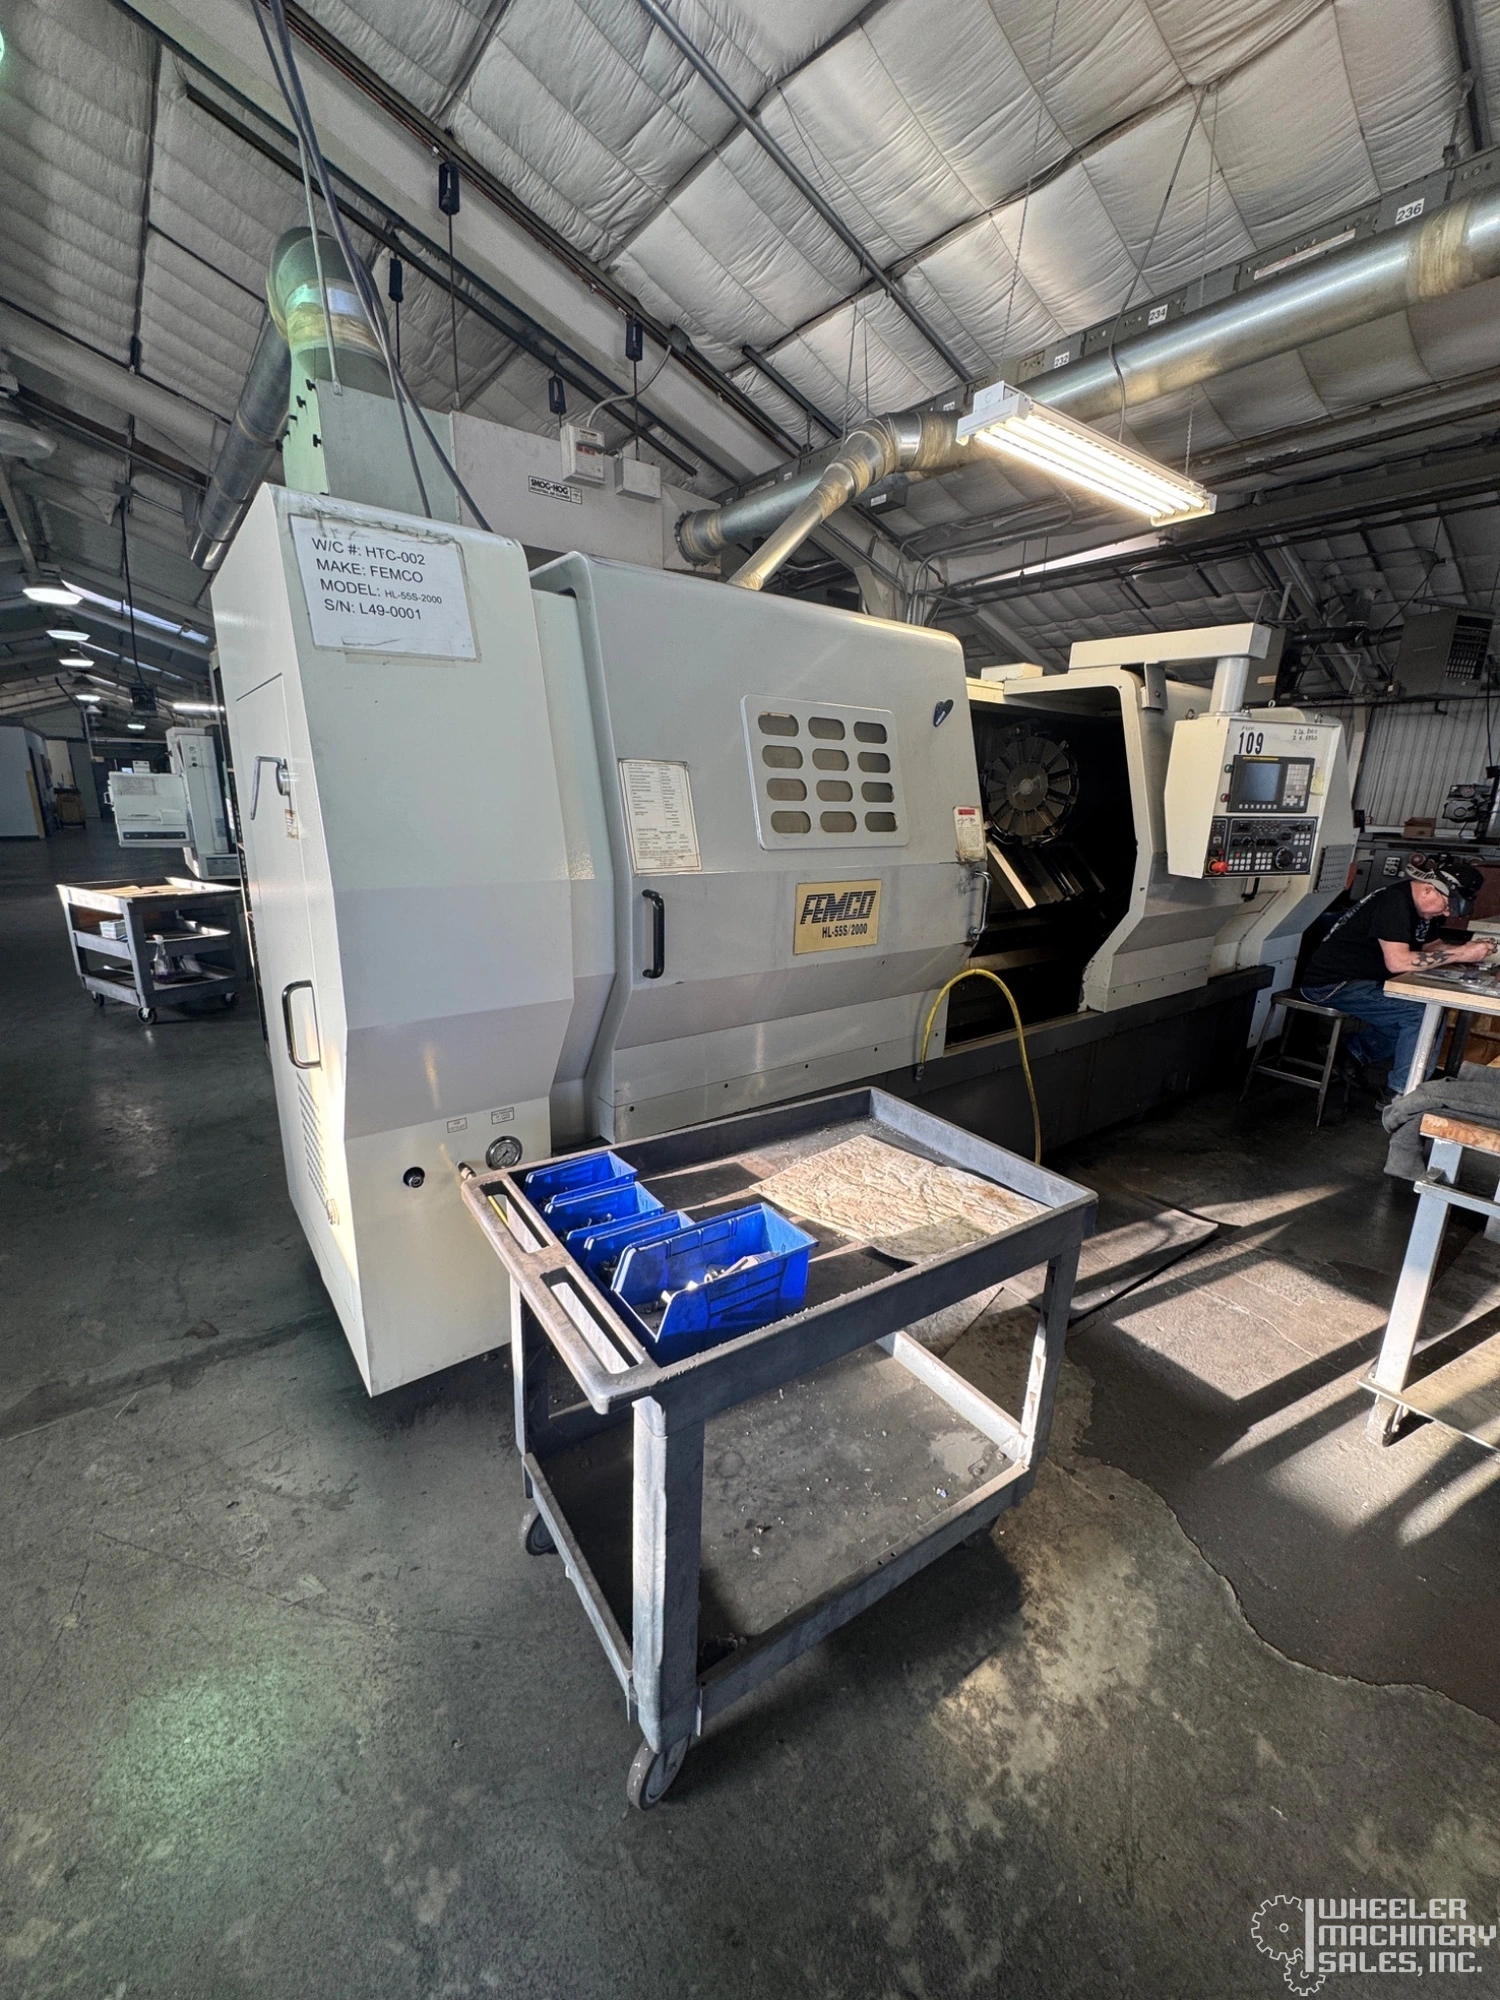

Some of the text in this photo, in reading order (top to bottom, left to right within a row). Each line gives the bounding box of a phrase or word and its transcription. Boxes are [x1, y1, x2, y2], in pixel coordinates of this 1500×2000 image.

[1397, 203, 1422, 222] 236
[1149, 308, 1166, 321] 234
[1055, 354, 1069, 367] 232
[531, 479, 568, 494] SMOG-HOG
[311, 537, 426, 566] W/C #: HTC-002
[316, 558, 424, 583] MAKE: FEMCO
[320, 578, 442, 604] MODEL: HL-55S-2000
[324, 598, 422, 620] S/N: L49-0001
[1239, 731, 1264, 755] 109
[800, 890, 877, 925] FEMCO
